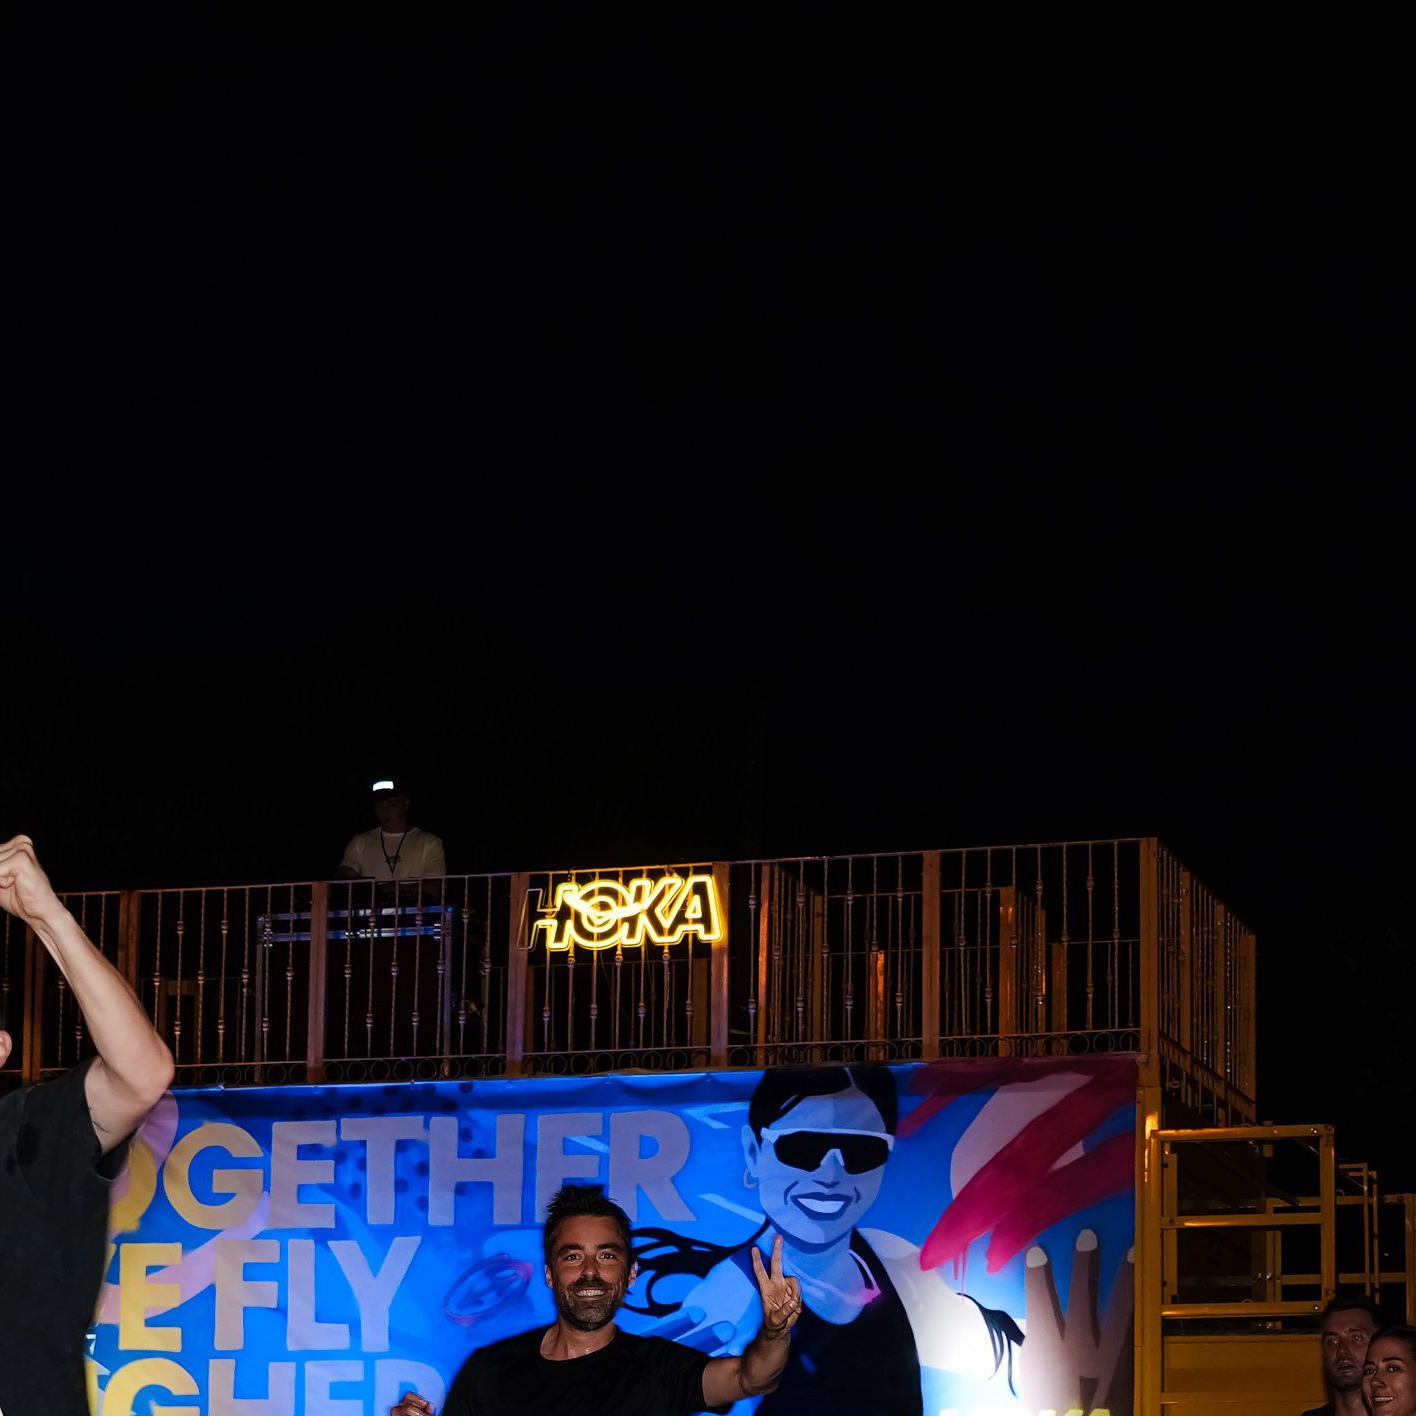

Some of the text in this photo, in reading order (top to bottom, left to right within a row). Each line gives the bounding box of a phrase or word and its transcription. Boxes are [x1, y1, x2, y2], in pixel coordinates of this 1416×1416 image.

[517, 874, 723, 952] HOKA
[110, 1107, 696, 1232] GETHER
[108, 1236, 421, 1352] E FLY
